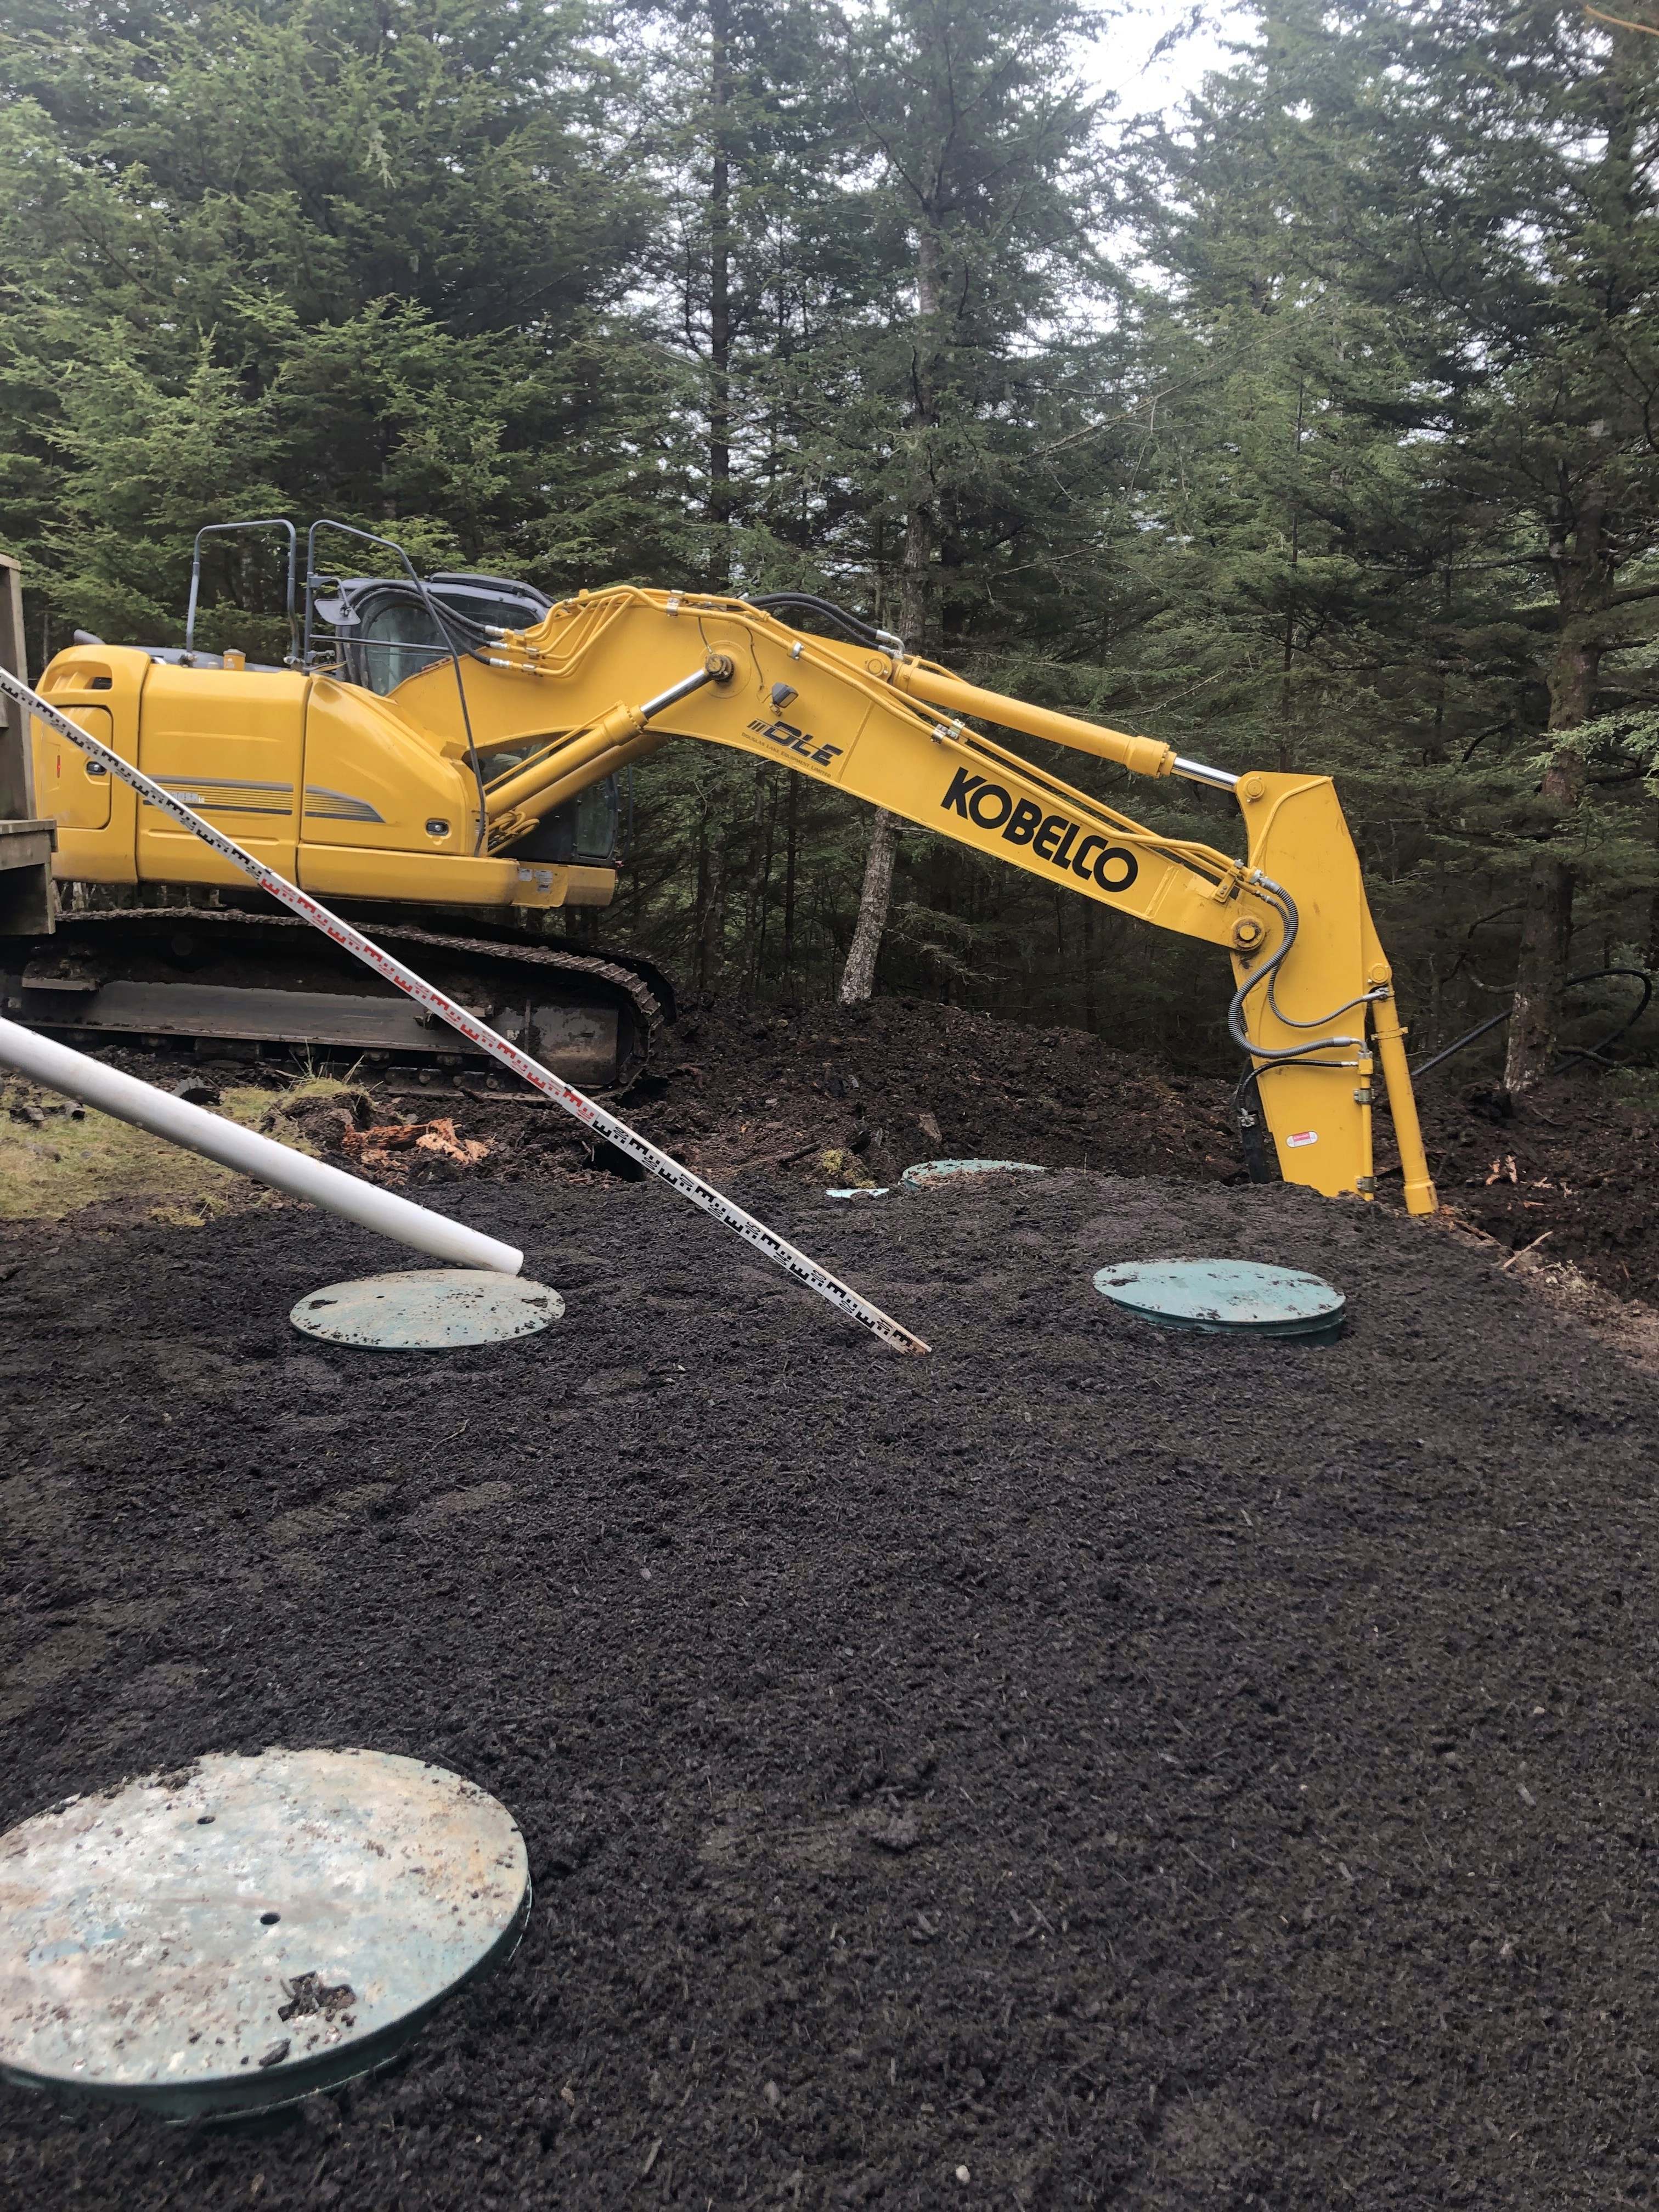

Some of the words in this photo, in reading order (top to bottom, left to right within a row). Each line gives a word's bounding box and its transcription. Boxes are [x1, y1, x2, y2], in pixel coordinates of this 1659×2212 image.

[761, 720, 844, 767] DLE
[741, 732, 765, 746] DOUGLAS
[766, 743, 779, 753] LAKE
[781, 751, 810, 768] EQUIPMENT
[811, 765, 831, 777] LIMITED
[941, 766, 1138, 893] KOBELCO
[547, 1079, 563, 1092] 11
[575, 1108, 591, 1122] 10
[613, 1126, 629, 1140] 09
[641, 1156, 658, 1170] 08
[679, 1173, 695, 1188] 07
[707, 1204, 724, 1218] 06
[744, 1221, 761, 1235] 05
[773, 1251, 789, 1265] 04
[810, 1269, 827, 1284] 03
[839, 1300, 855, 1313] 02
[876, 1317, 893, 1331] 01
